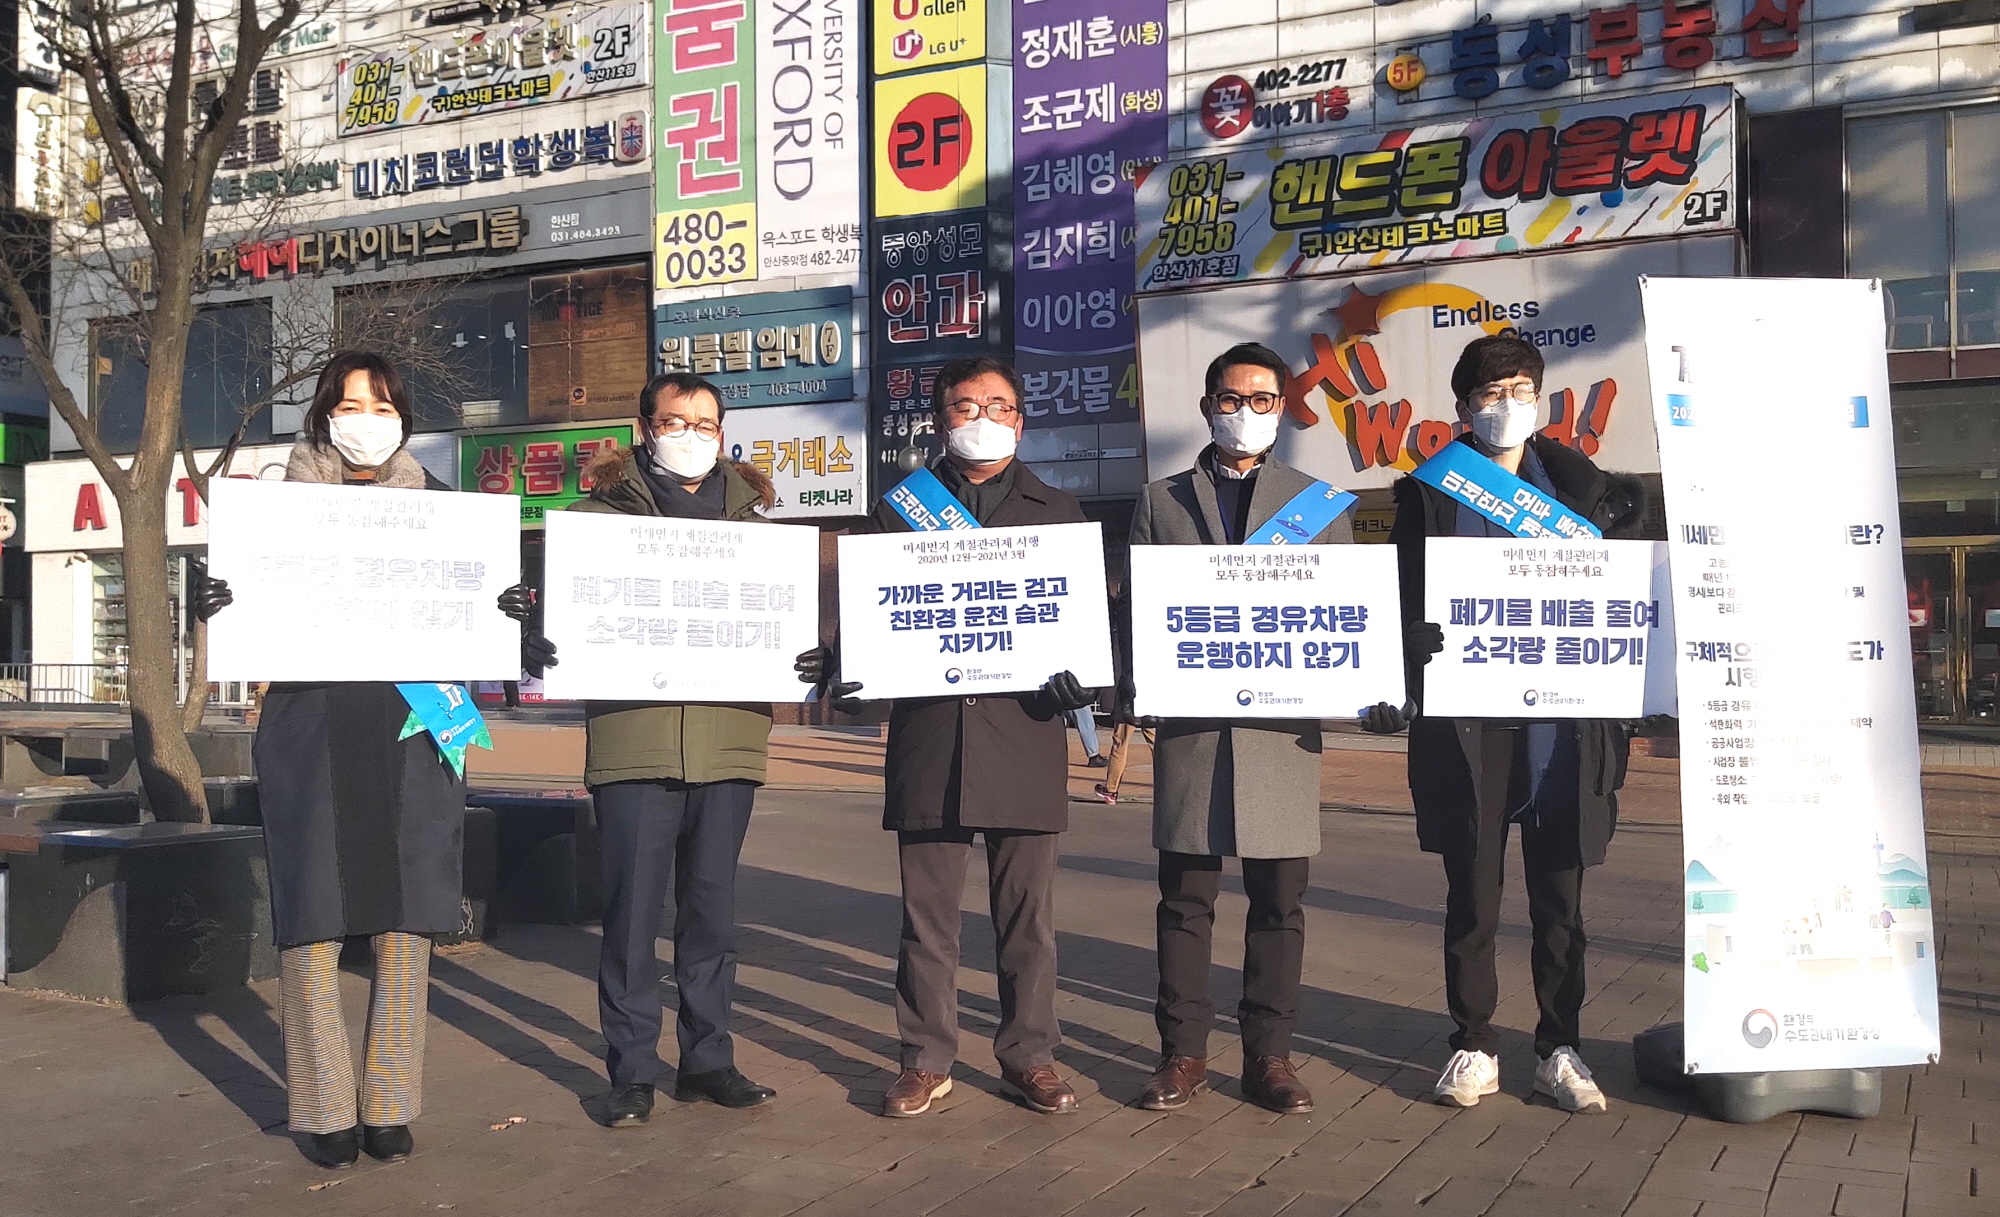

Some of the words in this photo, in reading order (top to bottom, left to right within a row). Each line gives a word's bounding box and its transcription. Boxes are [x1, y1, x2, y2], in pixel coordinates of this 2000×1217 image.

[595, 25, 631, 62] 2F
[930, 42, 946, 55] LG
[950, 38, 967, 51] U+
[1020, 15, 1117, 69] 정재훈
[1120, 21, 1164, 48] (시흥)
[353, 58, 405, 85] 031-
[585, 63, 636, 84] 안산11호점
[1255, 58, 1347, 92] 402-2277
[1392, 59, 1419, 85] 5F
[349, 84, 402, 107] 401-
[432, 75, 551, 112] 구)안산테크노마트
[1020, 82, 1117, 134] 조군제
[1120, 88, 1163, 115] (화성)
[1212, 84, 1247, 130] 꽃
[345, 101, 399, 128] 7958
[823, 112, 844, 150] OF
[897, 114, 964, 170] 2F
[353, 121, 616, 199] 미치코런던학생복
[1269, 136, 1472, 231] 핸드폰
[1480, 104, 1706, 199] 아울렛
[1021, 150, 1116, 202] 김혜영
[1168, 160, 1244, 197] 031-
[1164, 194, 1239, 226] 401-
[1685, 190, 1728, 225] 2F
[663, 210, 748, 246] 480-
[762, 229, 817, 247] 옥스포드
[822, 224, 864, 245] 학생복
[1158, 221, 1236, 259] 7958
[1300, 209, 1507, 257] 구)안산테크노마트
[810, 249, 863, 267] 482-2477
[882, 223, 983, 268] 중앙성모
[1022, 219, 1117, 270] 김지희
[666, 242, 747, 283] 0033
[1152, 254, 1241, 283] 안산11호점
[882, 270, 986, 343] 안과
[1023, 287, 1117, 333] 이아영
[1433, 300, 1540, 329] Endless
[1022, 365, 1112, 417] 본건물
[751, 436, 853, 479] 금거래소
[800, 489, 853, 507] 티켓나라
[903, 540, 950, 554] 미세먼지
[954, 537, 1013, 552] 계절관리제
[1017, 535, 1039, 548] 시행
[917, 553, 948, 564] 2020년
[951, 551, 1008, 563] 12월~2021년
[1011, 549, 1026, 560] 3월
[1503, 548, 1547, 562] 미세먼지
[1552, 549, 1609, 563] 계절관리제
[1209, 554, 1256, 567] 미세먼지
[1260, 554, 1320, 567] 계절관리제
[1215, 569, 1239, 581] 모두
[1242, 568, 1315, 582] 동참해주세요
[1508, 565, 1531, 577] 모두
[1535, 564, 1604, 578] 동참해주세요
[572, 576, 661, 607] 폐기물
[673, 580, 730, 610] 배출
[740, 582, 795, 612] 줄여
[878, 583, 944, 605] 가까운
[952, 580, 1018, 602] 거리는
[1025, 577, 1068, 598] 걷고
[890, 608, 957, 631] 친환경
[964, 605, 1008, 628] 운전
[1015, 602, 1060, 624] 습관
[1166, 606, 1241, 633] 5등급
[1251, 605, 1368, 633] 경유차량
[1450, 598, 1533, 627] 폐기물
[1541, 599, 1594, 627] 배출
[1606, 599, 1660, 628] 줄여
[587, 616, 678, 647] 소각량
[687, 618, 781, 649] 줄이기!
[939, 630, 1013, 654] 지키기!
[1176, 641, 1293, 669] 운행하지
[1302, 641, 1360, 669] 않기
[1462, 636, 1546, 665] 소각량
[1555, 637, 1643, 665] 줄이기!
[1707, 701, 1729, 712] 5등급
[1709, 718, 1743, 730] 석탄화력
[1713, 756, 1736, 768] 사업장
[1715, 775, 1748, 786] 도로청소
